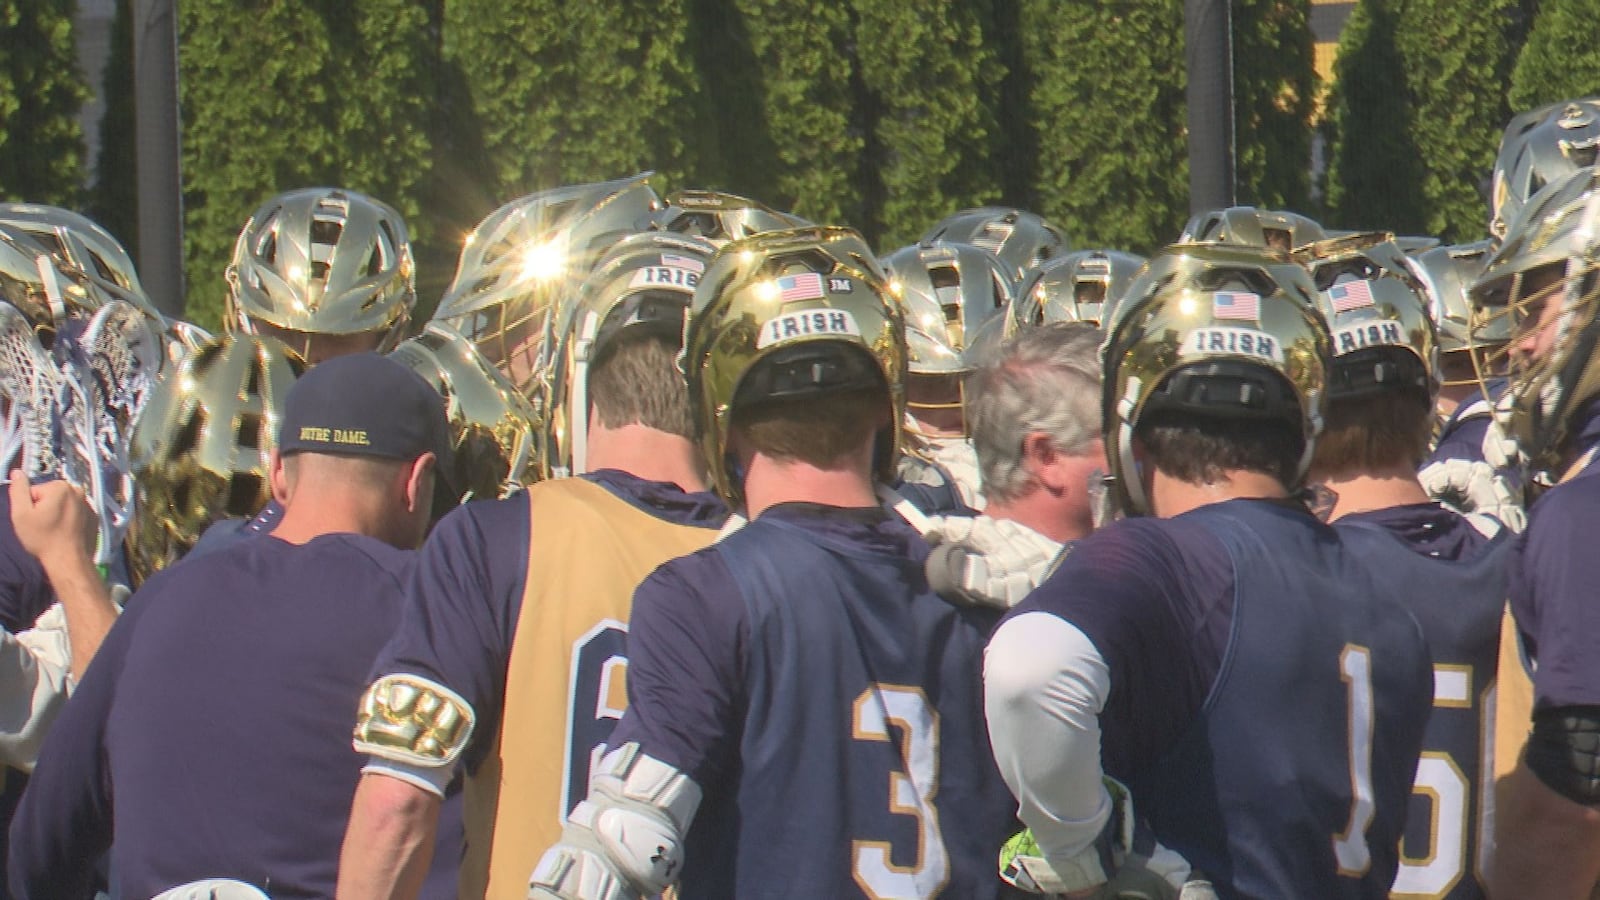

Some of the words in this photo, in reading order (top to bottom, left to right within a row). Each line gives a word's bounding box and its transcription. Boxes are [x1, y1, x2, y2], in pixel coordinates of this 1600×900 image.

[645, 267, 699, 287] IRIS
[771, 312, 848, 340] IRISH
[1197, 331, 1275, 358] IRISH
[300, 427, 331, 442] NOTRE
[1330, 642, 1375, 877] 1
[852, 682, 950, 900] 3
